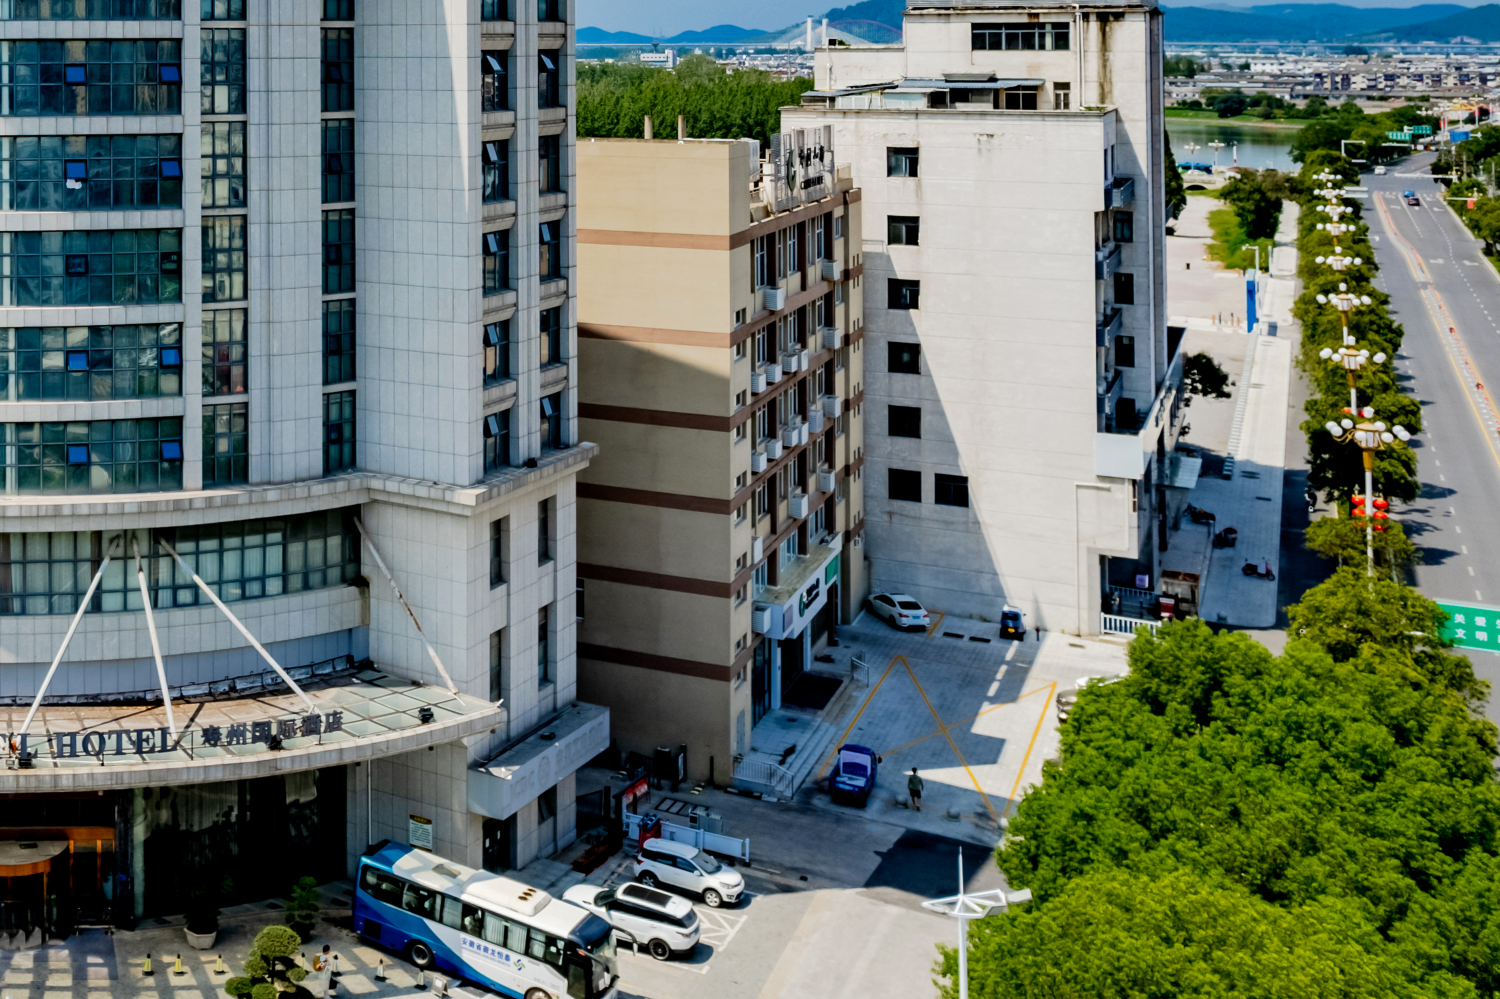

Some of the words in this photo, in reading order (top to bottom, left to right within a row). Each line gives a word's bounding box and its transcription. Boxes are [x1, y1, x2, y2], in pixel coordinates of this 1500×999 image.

[1455, 628, 1500, 644] 文明
[55, 726, 178, 759] HOTEL
[201, 709, 344, 748] 寿州国际酒店
